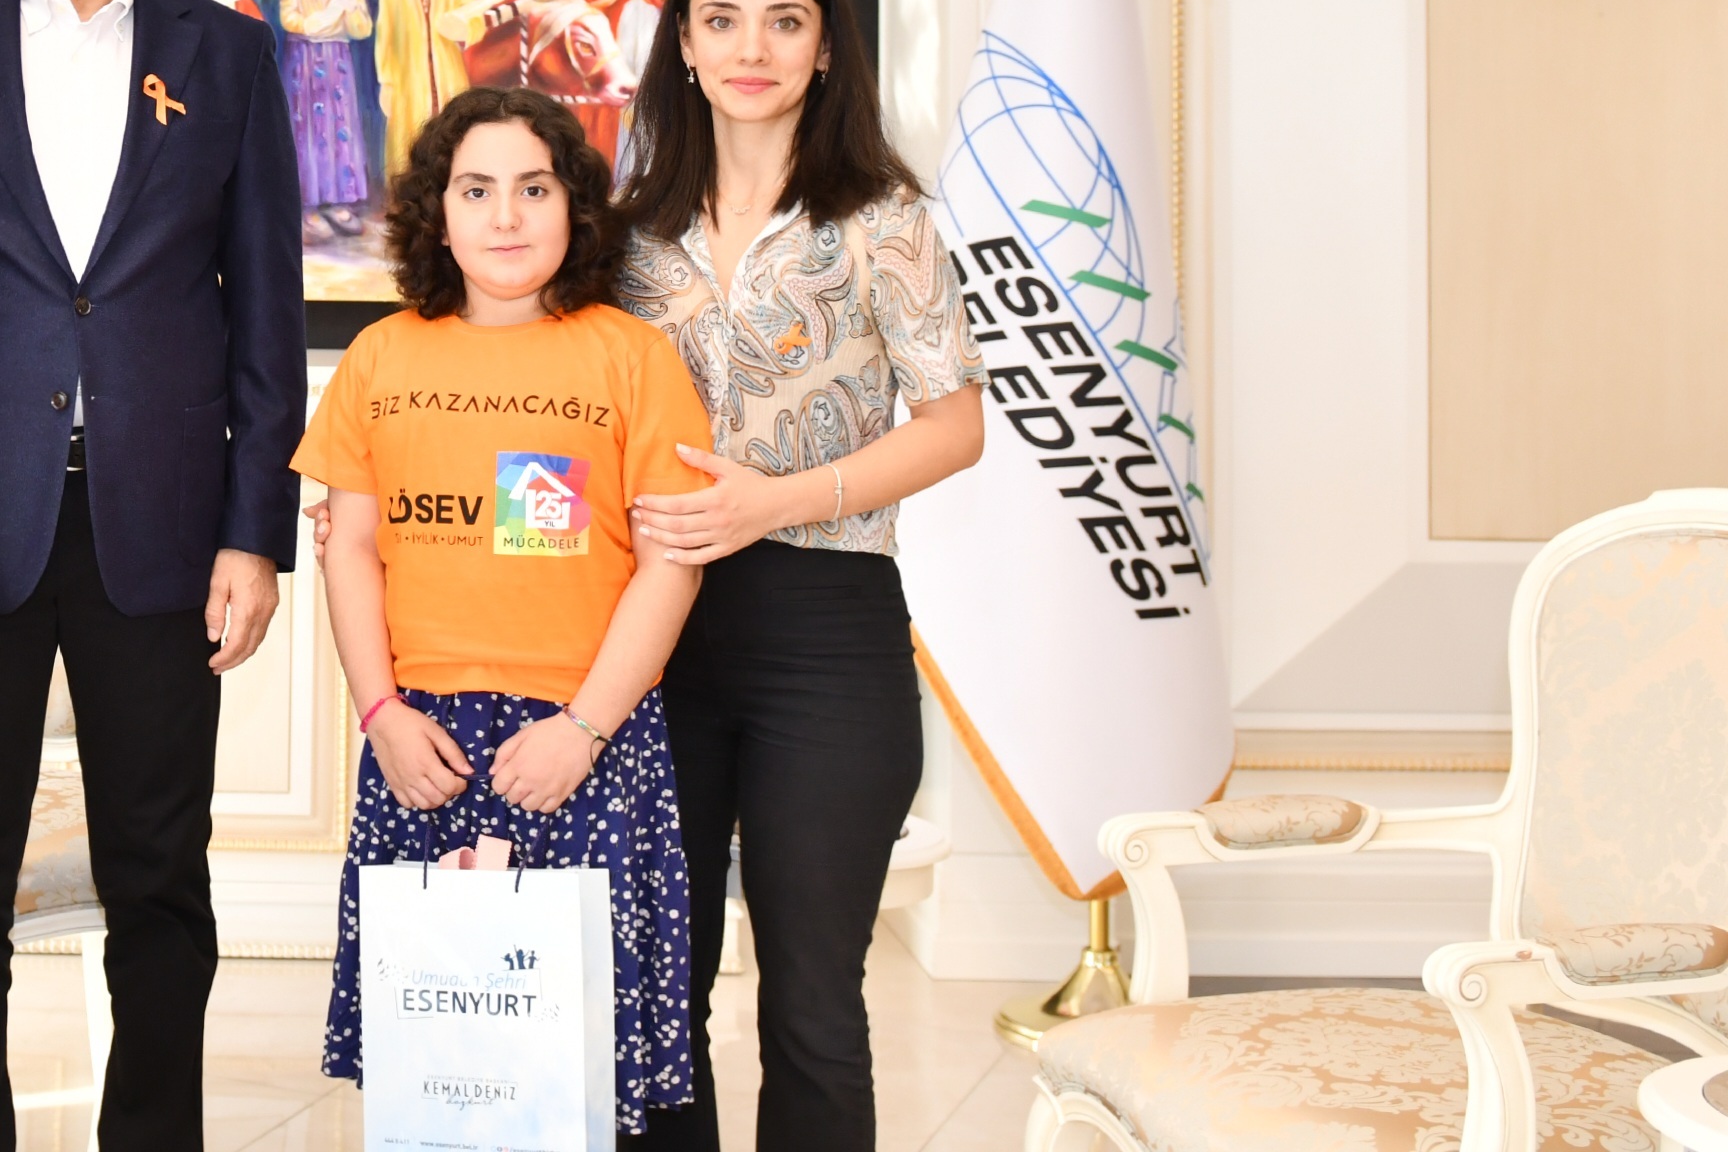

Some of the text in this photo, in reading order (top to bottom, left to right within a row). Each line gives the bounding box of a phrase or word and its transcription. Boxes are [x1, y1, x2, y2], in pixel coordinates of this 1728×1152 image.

[371, 390, 610, 427] BİZ KAZANACAĞIZ
[967, 236, 1209, 588] ESENYURT
[949, 250, 1190, 622] ELEDİYESİ
[447, 535, 483, 546] UMUT
[503, 535, 579, 549] MÜCADELE
[485, 973, 528, 992] Şehri
[403, 989, 537, 1018] ESENYURT
